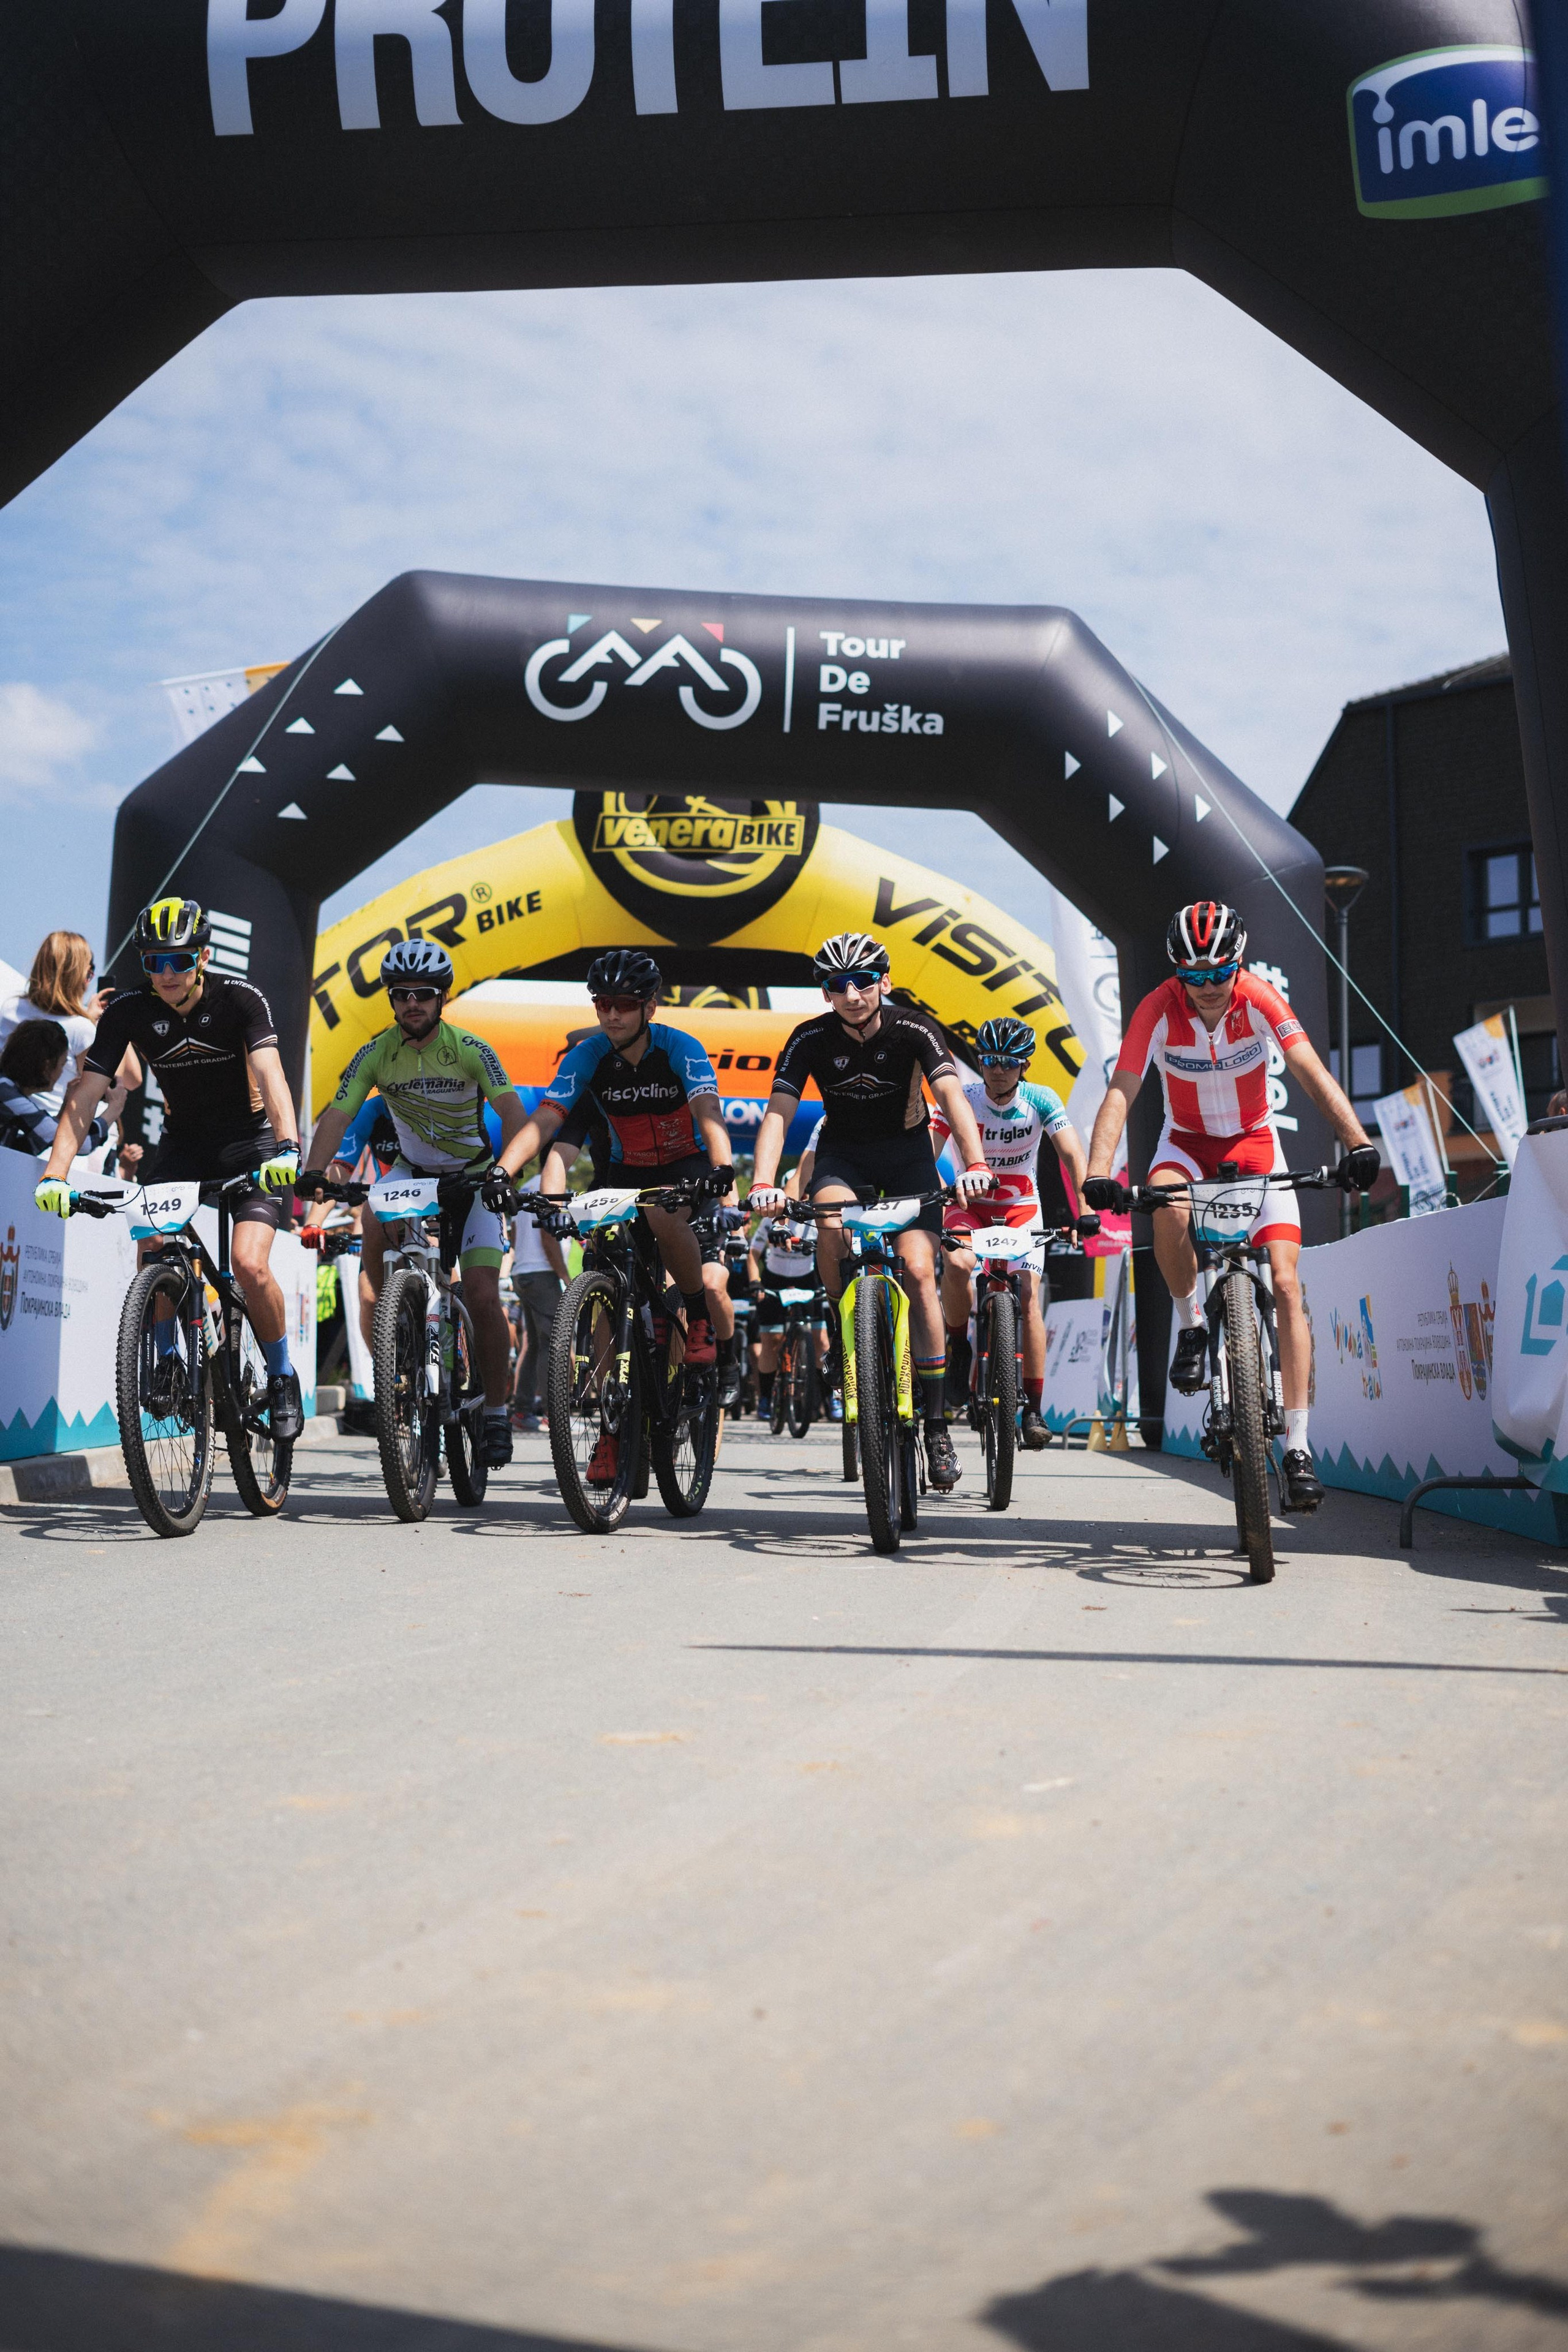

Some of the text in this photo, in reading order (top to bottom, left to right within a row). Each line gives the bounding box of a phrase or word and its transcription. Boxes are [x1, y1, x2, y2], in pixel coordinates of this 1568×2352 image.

[820, 631, 906, 659] Tour
[819, 665, 870, 694] De
[818, 703, 944, 735] Fruška
[739, 823, 796, 846] BIKE
[476, 889, 543, 935] BIKE
[386, 1079, 466, 1093] Cyclemania
[601, 1083, 679, 1102] riscycling
[383, 1189, 421, 1202] 1246
[140, 1198, 182, 1216] 1249
[1210, 1202, 1253, 1219] 1235
[985, 1237, 1017, 1247] 1247
[1273, 1371, 1284, 1406] ROCKSHOX
